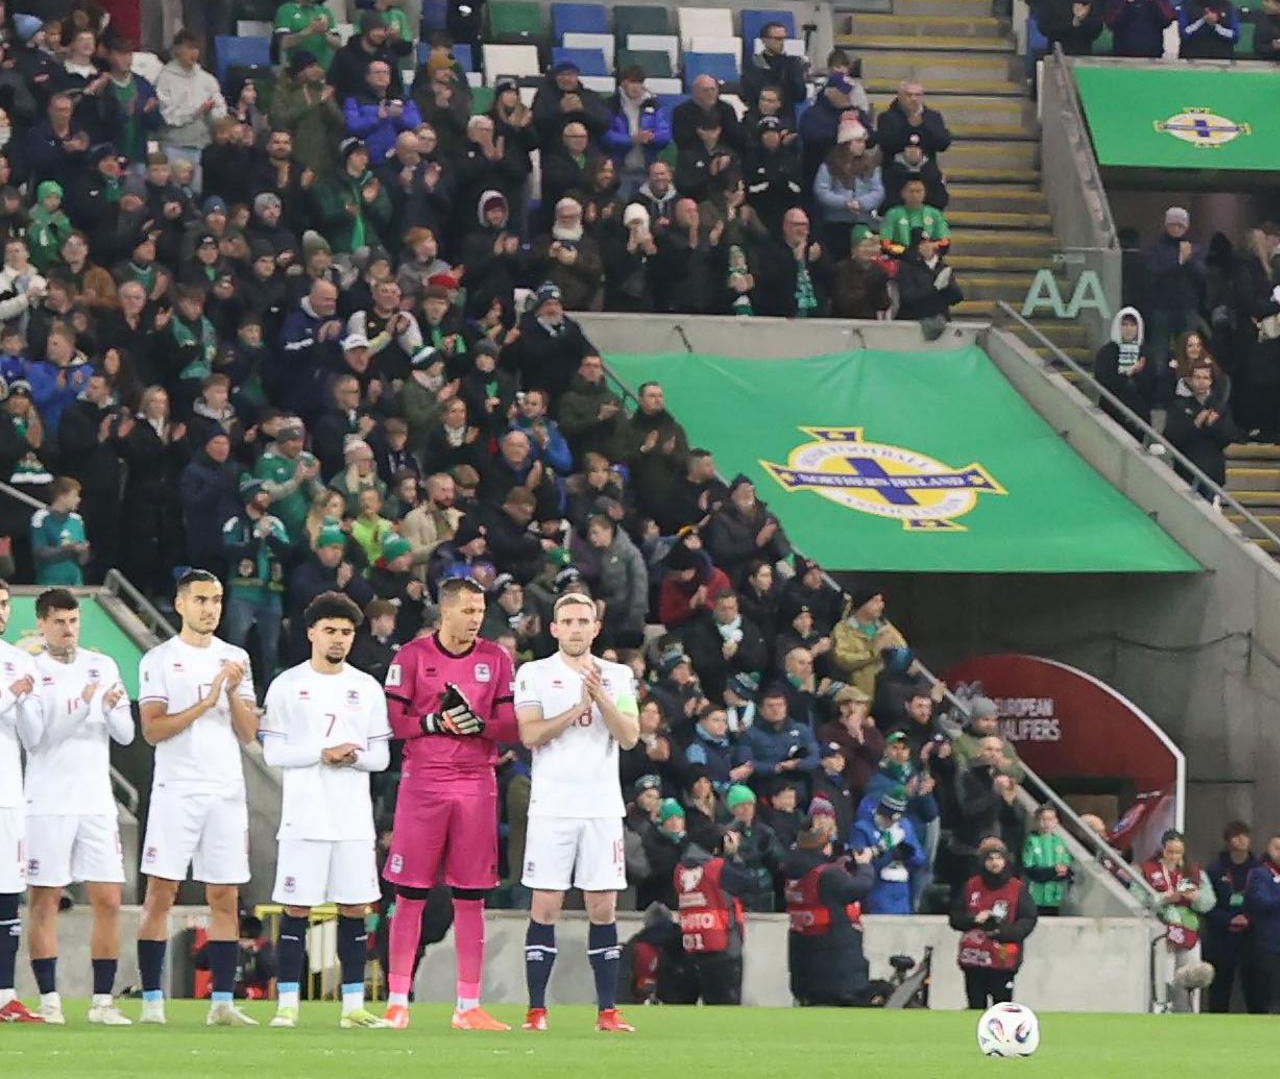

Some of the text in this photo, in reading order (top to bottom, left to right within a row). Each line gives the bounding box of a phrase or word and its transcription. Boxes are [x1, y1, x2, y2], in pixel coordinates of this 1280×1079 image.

[1021, 269, 1112, 320] AA
[324, 713, 337, 738] 7
[999, 718, 1061, 742] ALIFIERS
